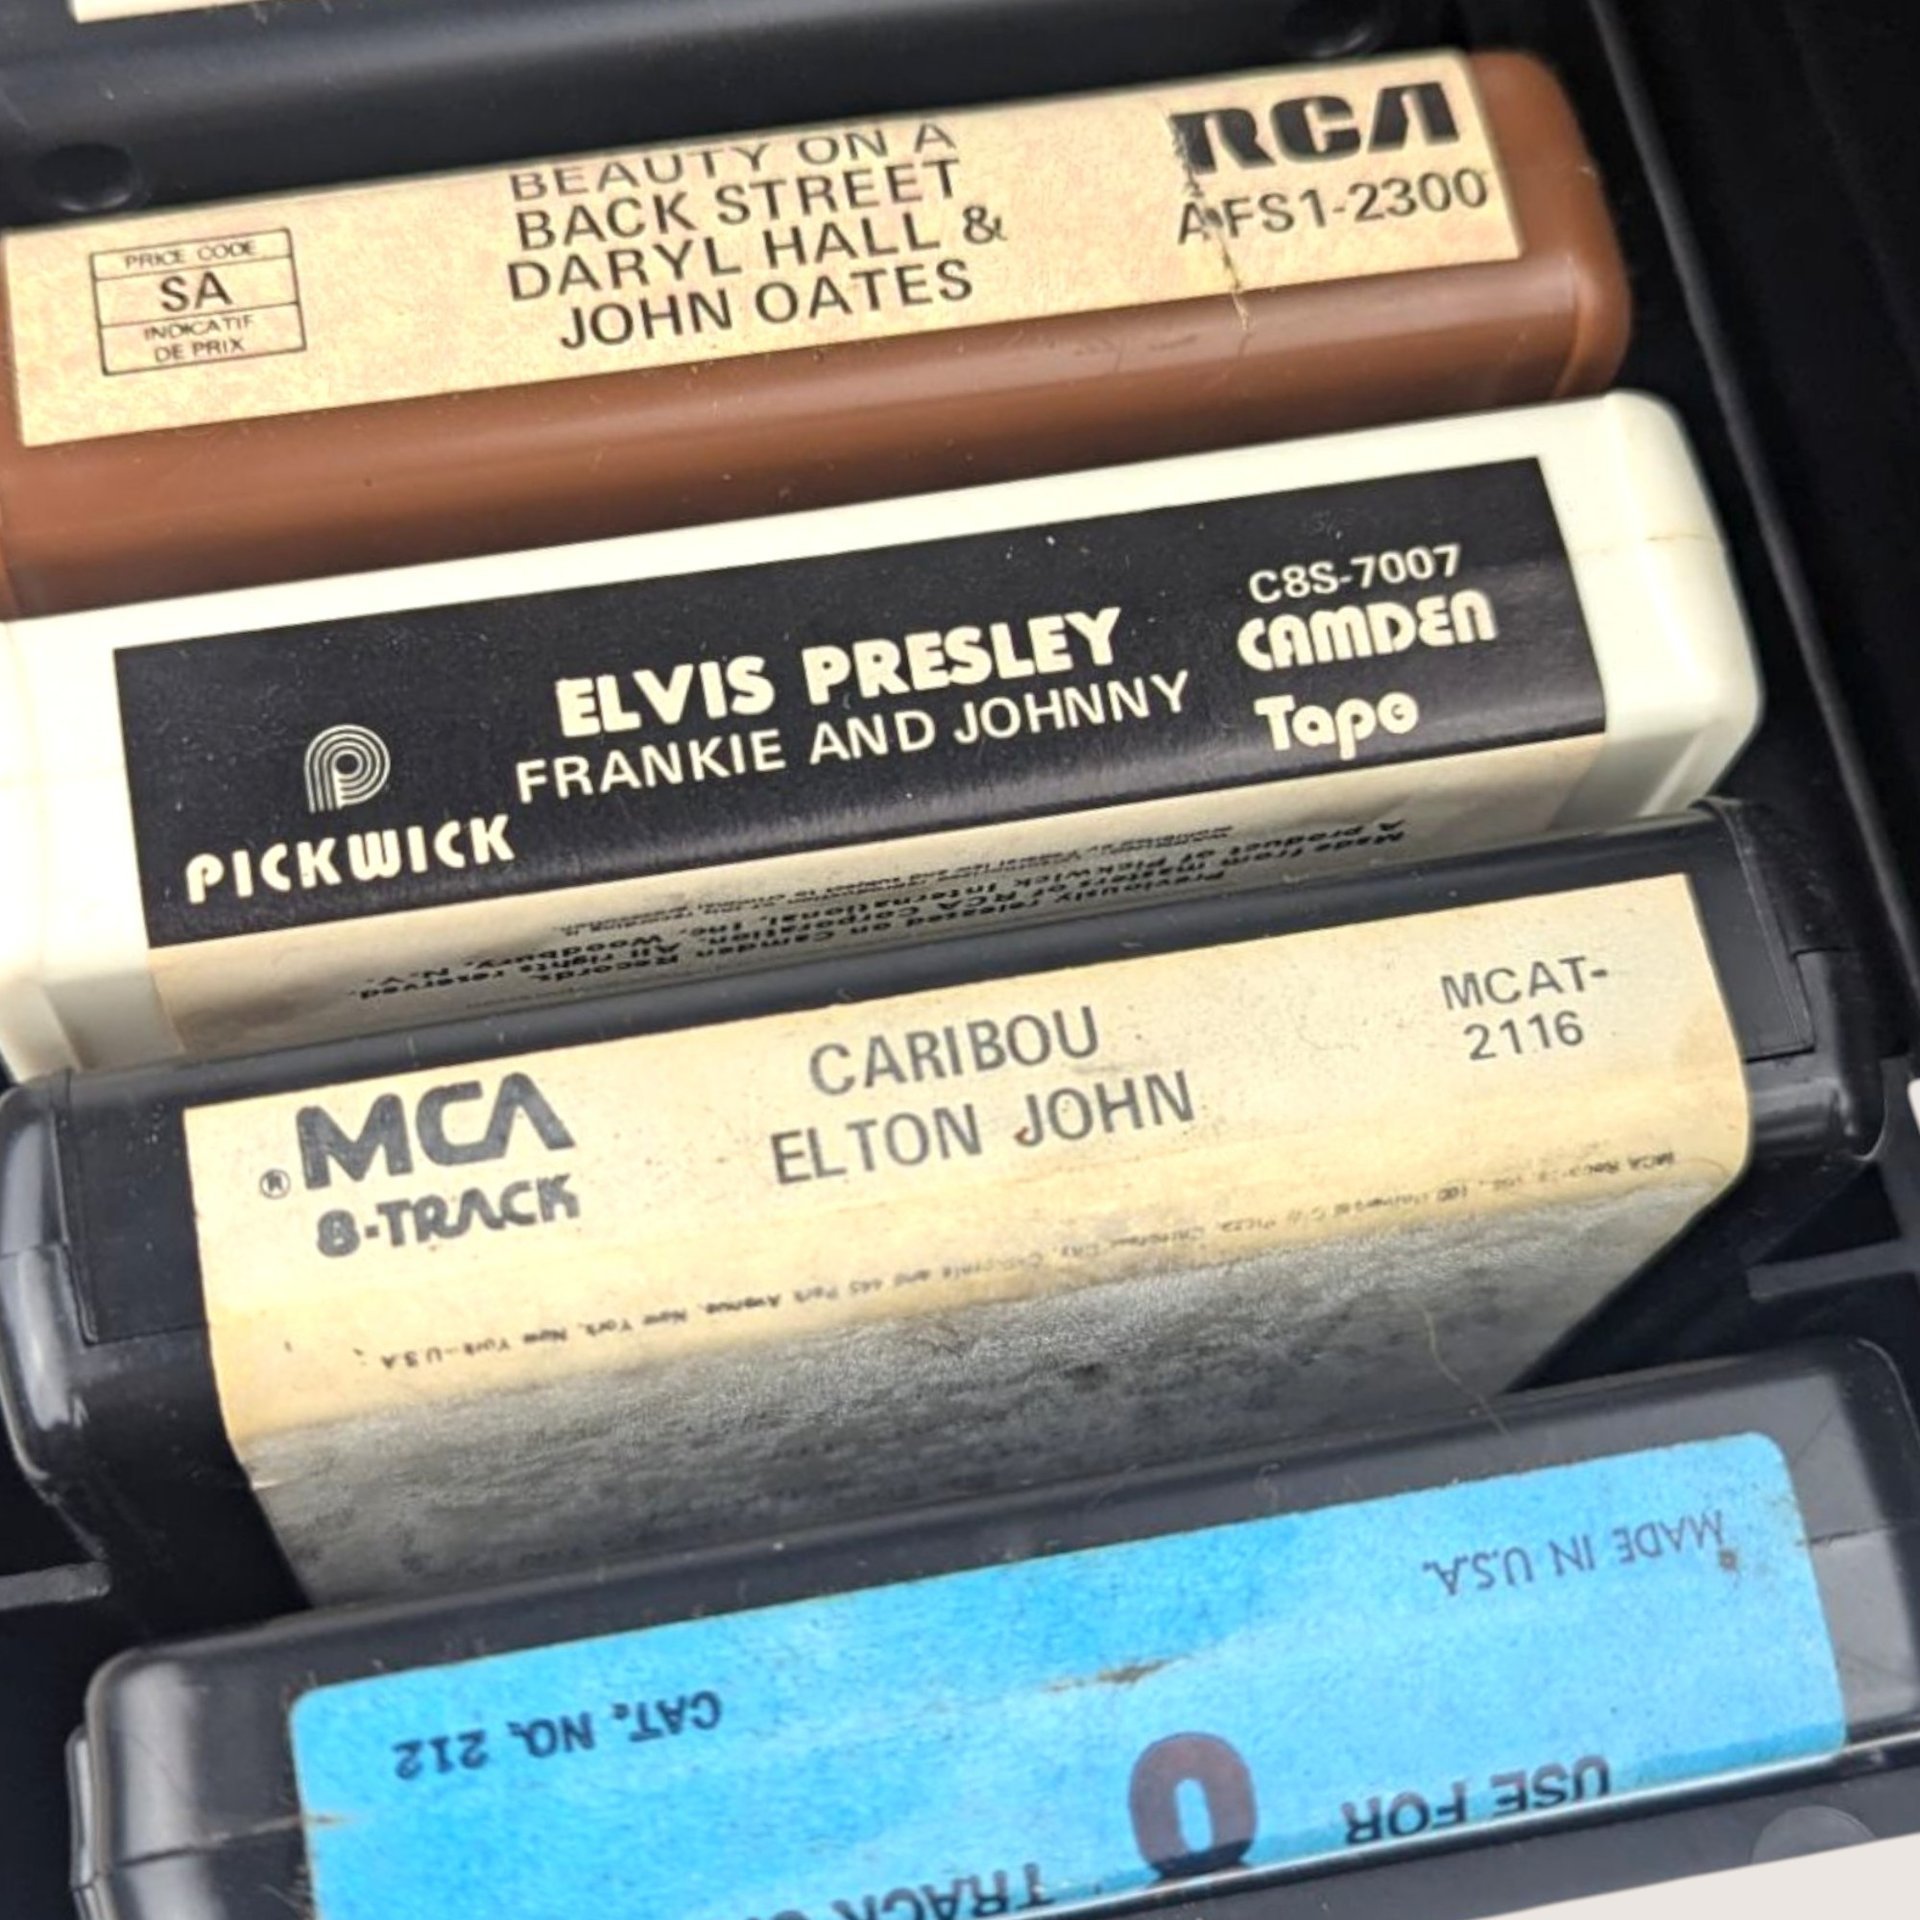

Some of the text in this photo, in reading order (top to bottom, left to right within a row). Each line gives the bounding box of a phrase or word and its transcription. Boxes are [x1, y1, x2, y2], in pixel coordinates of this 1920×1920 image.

[509, 123, 957, 202] BEAUTY ON A
[1170, 81, 1459, 175] RCA
[516, 158, 961, 252] BACK STREET
[1177, 167, 1489, 244] AFS1-2300
[124, 240, 258, 269] PRICE CODE
[160, 271, 233, 312] SA
[507, 205, 1008, 301] DARYL HALL &
[143, 314, 255, 341] INDICATIF
[560, 259, 973, 350] JOHN OATES
[154, 338, 246, 363] DE PRIX
[1249, 544, 1462, 604] C8S-7007
[1236, 589, 1497, 671] CAMDEN
[554, 607, 1122, 738] ELVIS PRESLEY
[515, 671, 1190, 804] FRANKIE AND JOHNNY
[1255, 692, 1420, 761] Tape
[186, 813, 515, 904] PICKWICK
[1440, 956, 1609, 1011] MCAT-
[809, 1005, 1099, 1096] CARIBOU
[1465, 1009, 1585, 1063] 2116
[296, 1072, 575, 1190] MCA
[770, 1070, 1194, 1185] ELTON JOHN
[317, 1173, 580, 1257] 8-TRACK
[1422, 1510, 1726, 1597] MADE IN U.S.A.
[392, 1729, 488, 1780] 212
[612, 1690, 722, 1742] CAT.
[1341, 1781, 1467, 1846] FOR
[1490, 1755, 1611, 1811] USE
